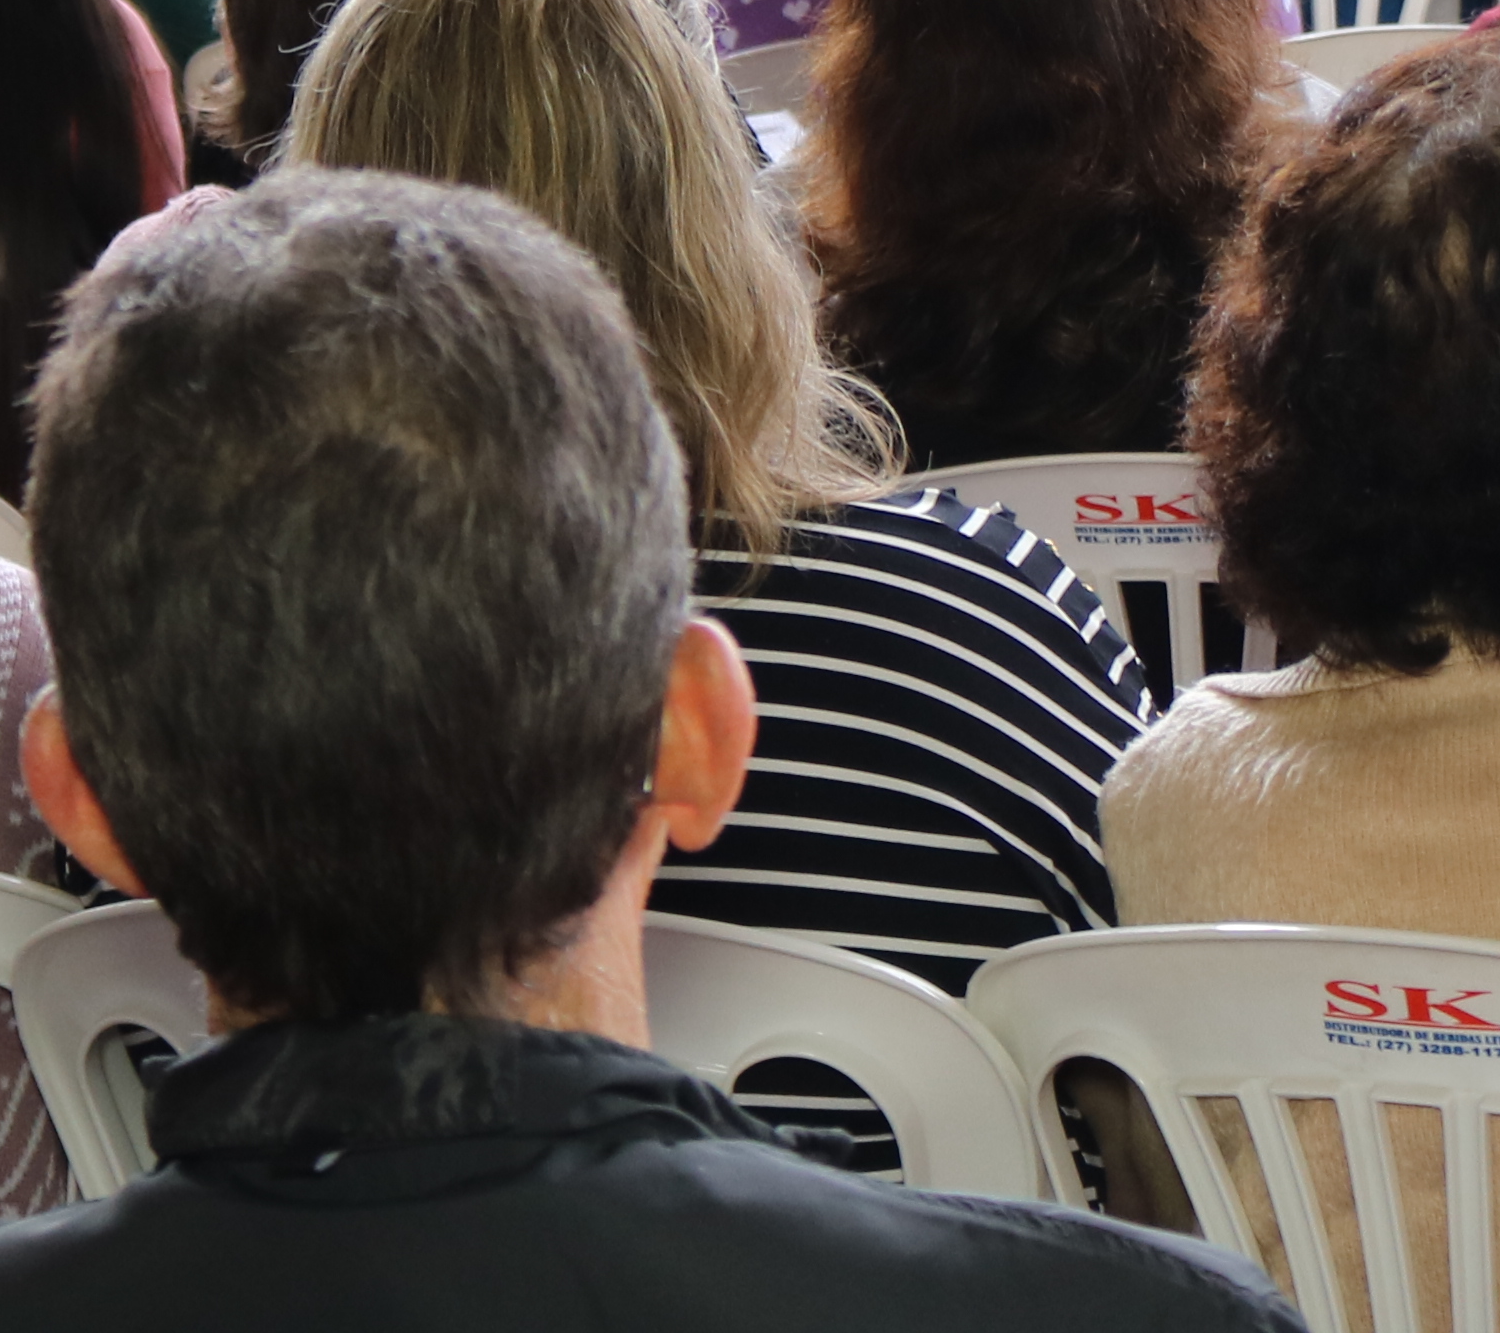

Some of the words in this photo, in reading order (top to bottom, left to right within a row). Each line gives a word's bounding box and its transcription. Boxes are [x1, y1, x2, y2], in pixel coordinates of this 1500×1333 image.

[1074, 493, 1198, 523] SK
[1114, 535, 1141, 546] (27)
[1324, 1021, 1412, 1040] DISTRIBUIDORA
[1414, 1030, 1429, 1041] DE
[1433, 1031, 1482, 1045] BEBIDAS
[1325, 1032, 1371, 1047] TEL.:
[1376, 1038, 1413, 1053] (27)
